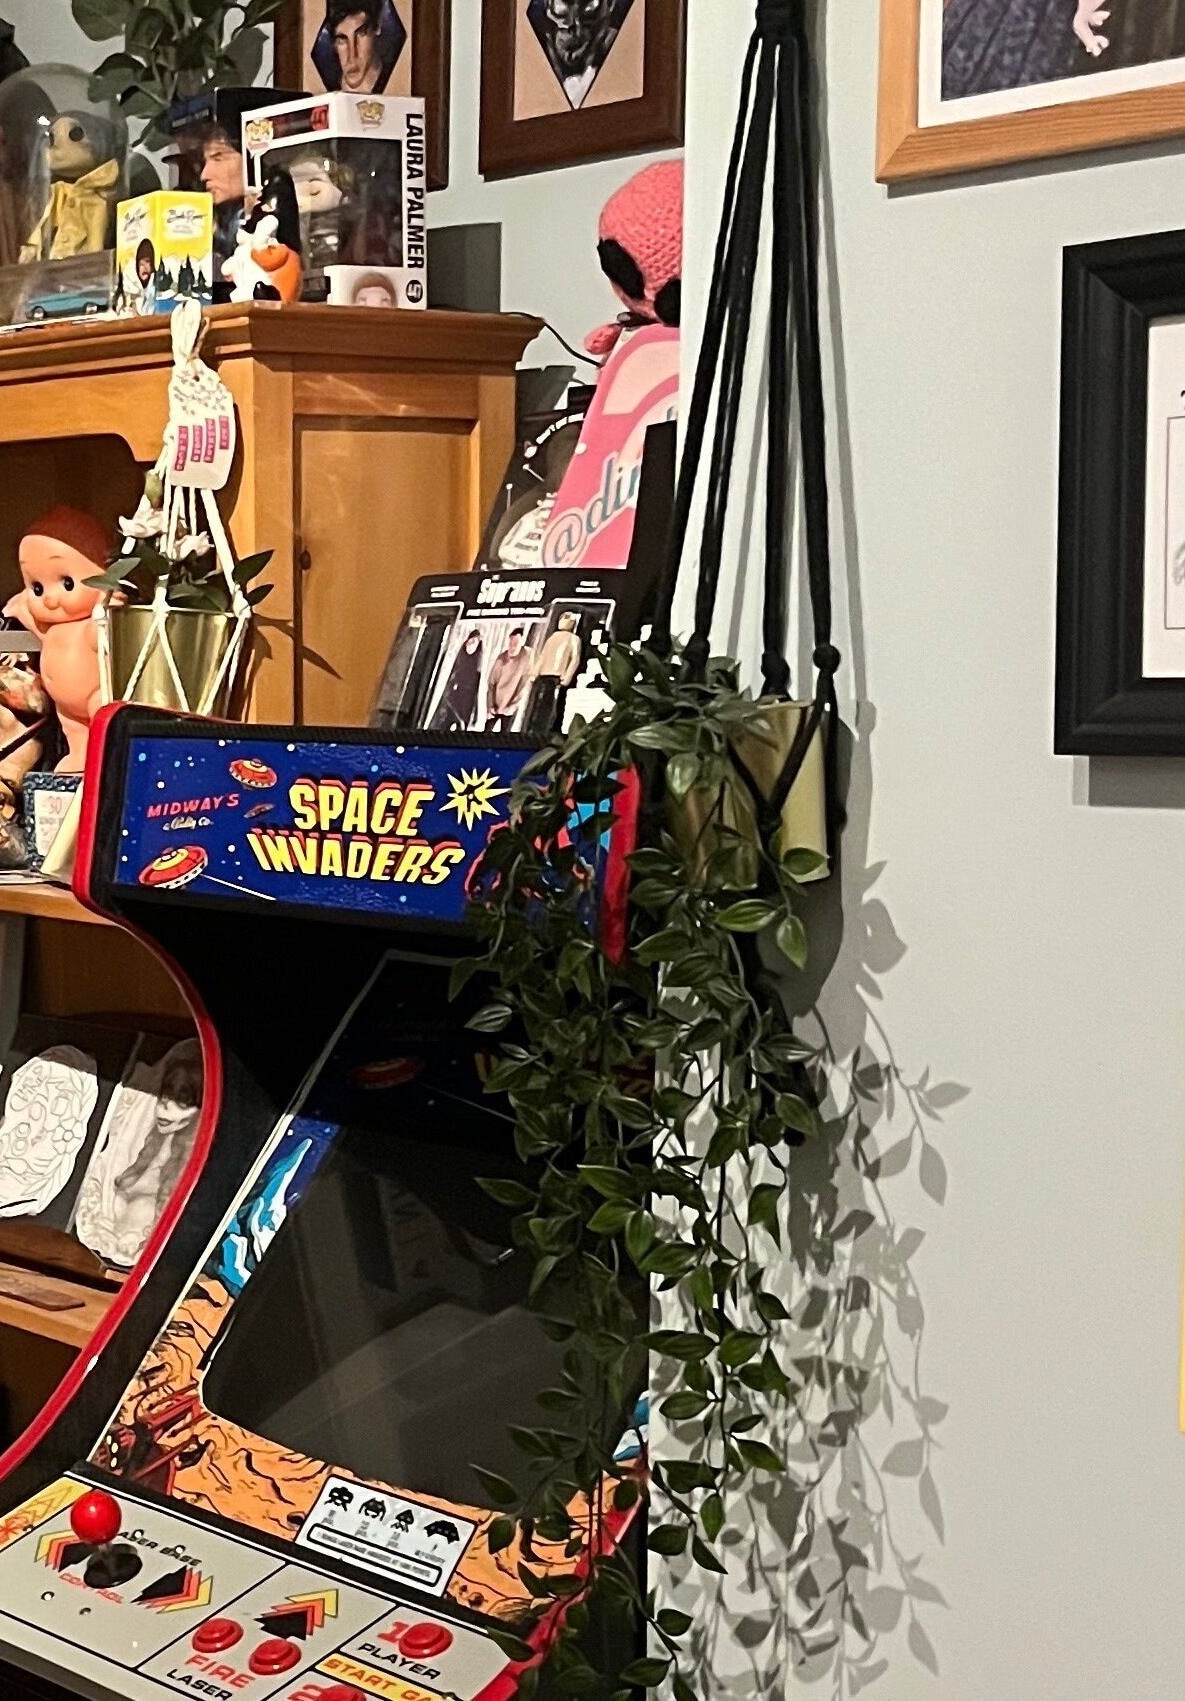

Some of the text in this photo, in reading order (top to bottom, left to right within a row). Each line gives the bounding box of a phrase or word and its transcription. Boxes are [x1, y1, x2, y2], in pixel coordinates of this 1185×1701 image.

[406, 113, 425, 269] LAURA PALMER
[288, 779, 435, 837] SPACE
[246, 828, 467, 885] INVADERS
[185, 1654, 256, 1688] FIRE
[324, 1658, 397, 1690] START
[358, 1642, 441, 1680] PLAYER
[166, 1668, 233, 1701] LASER
